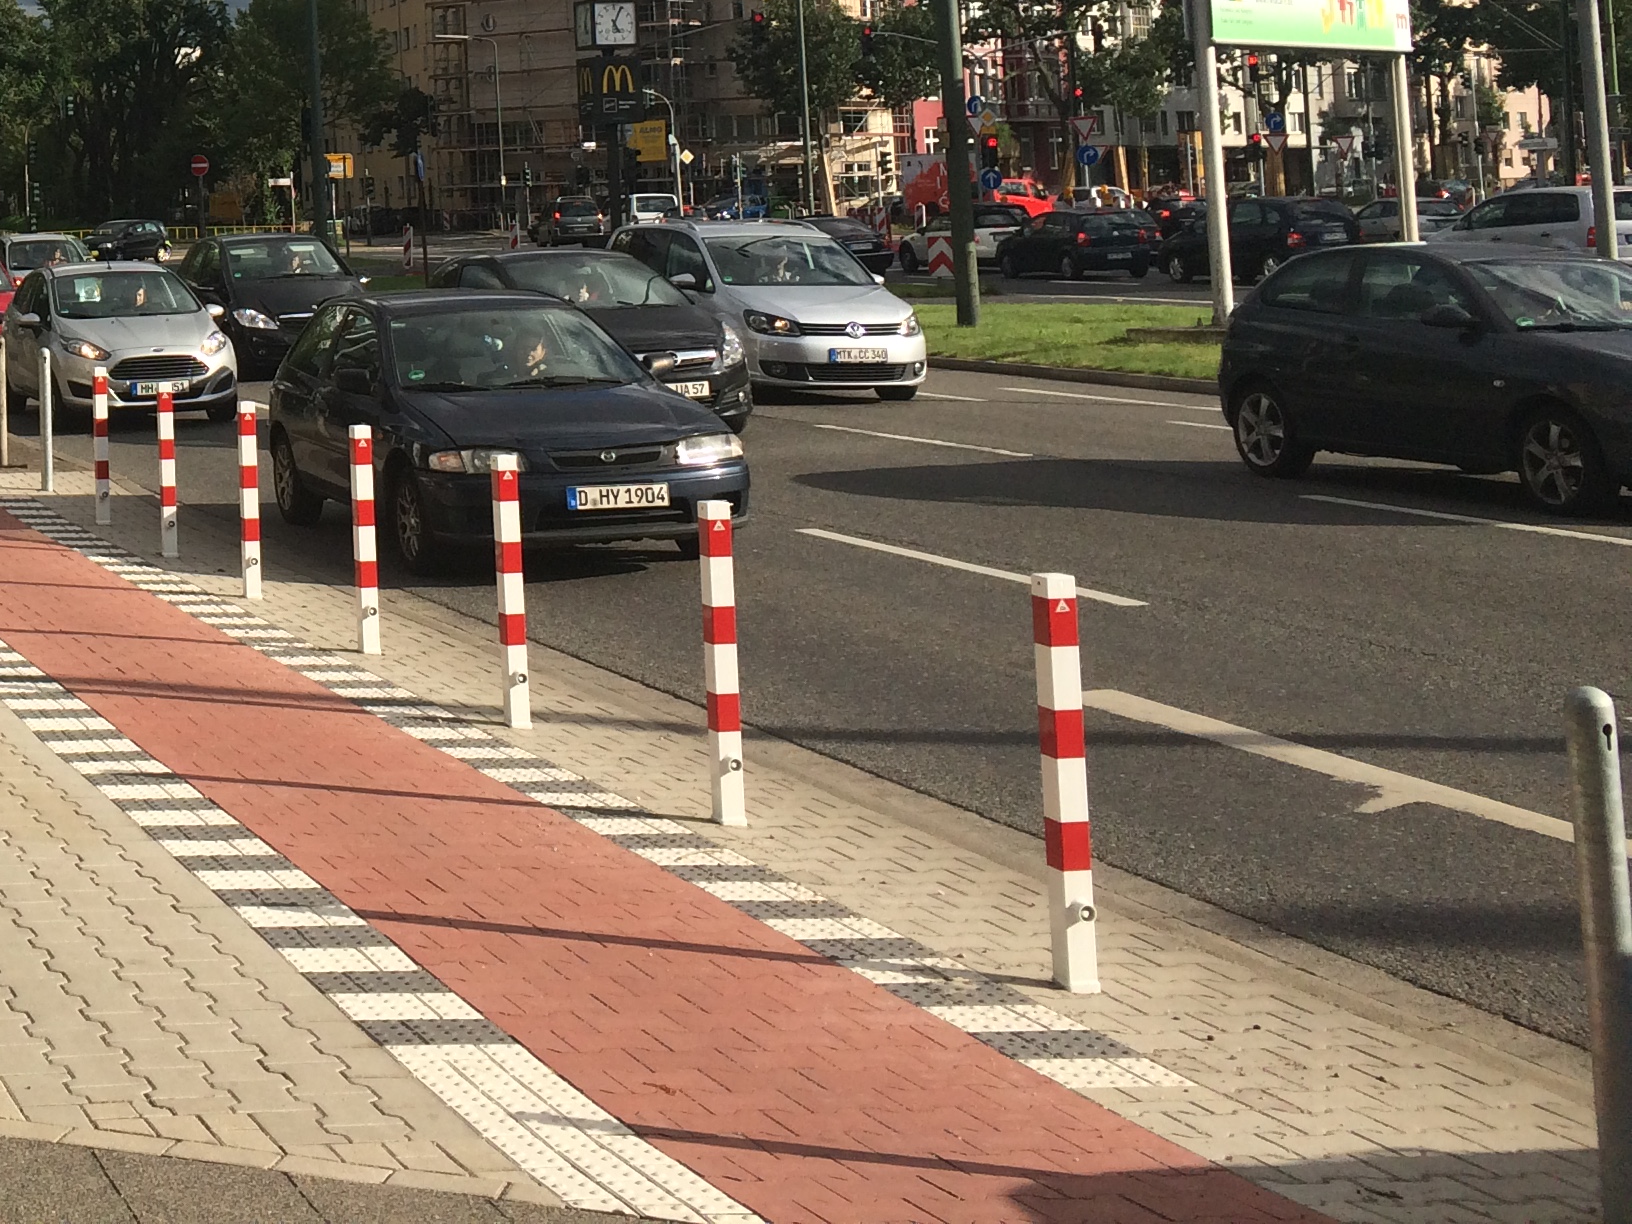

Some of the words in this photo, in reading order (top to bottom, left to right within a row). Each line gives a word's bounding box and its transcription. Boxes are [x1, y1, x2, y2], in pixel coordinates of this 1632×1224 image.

[692, 383, 705, 394] 57
[577, 489, 589, 507] D
[598, 488, 620, 506] HY
[624, 486, 666, 505] 1904
